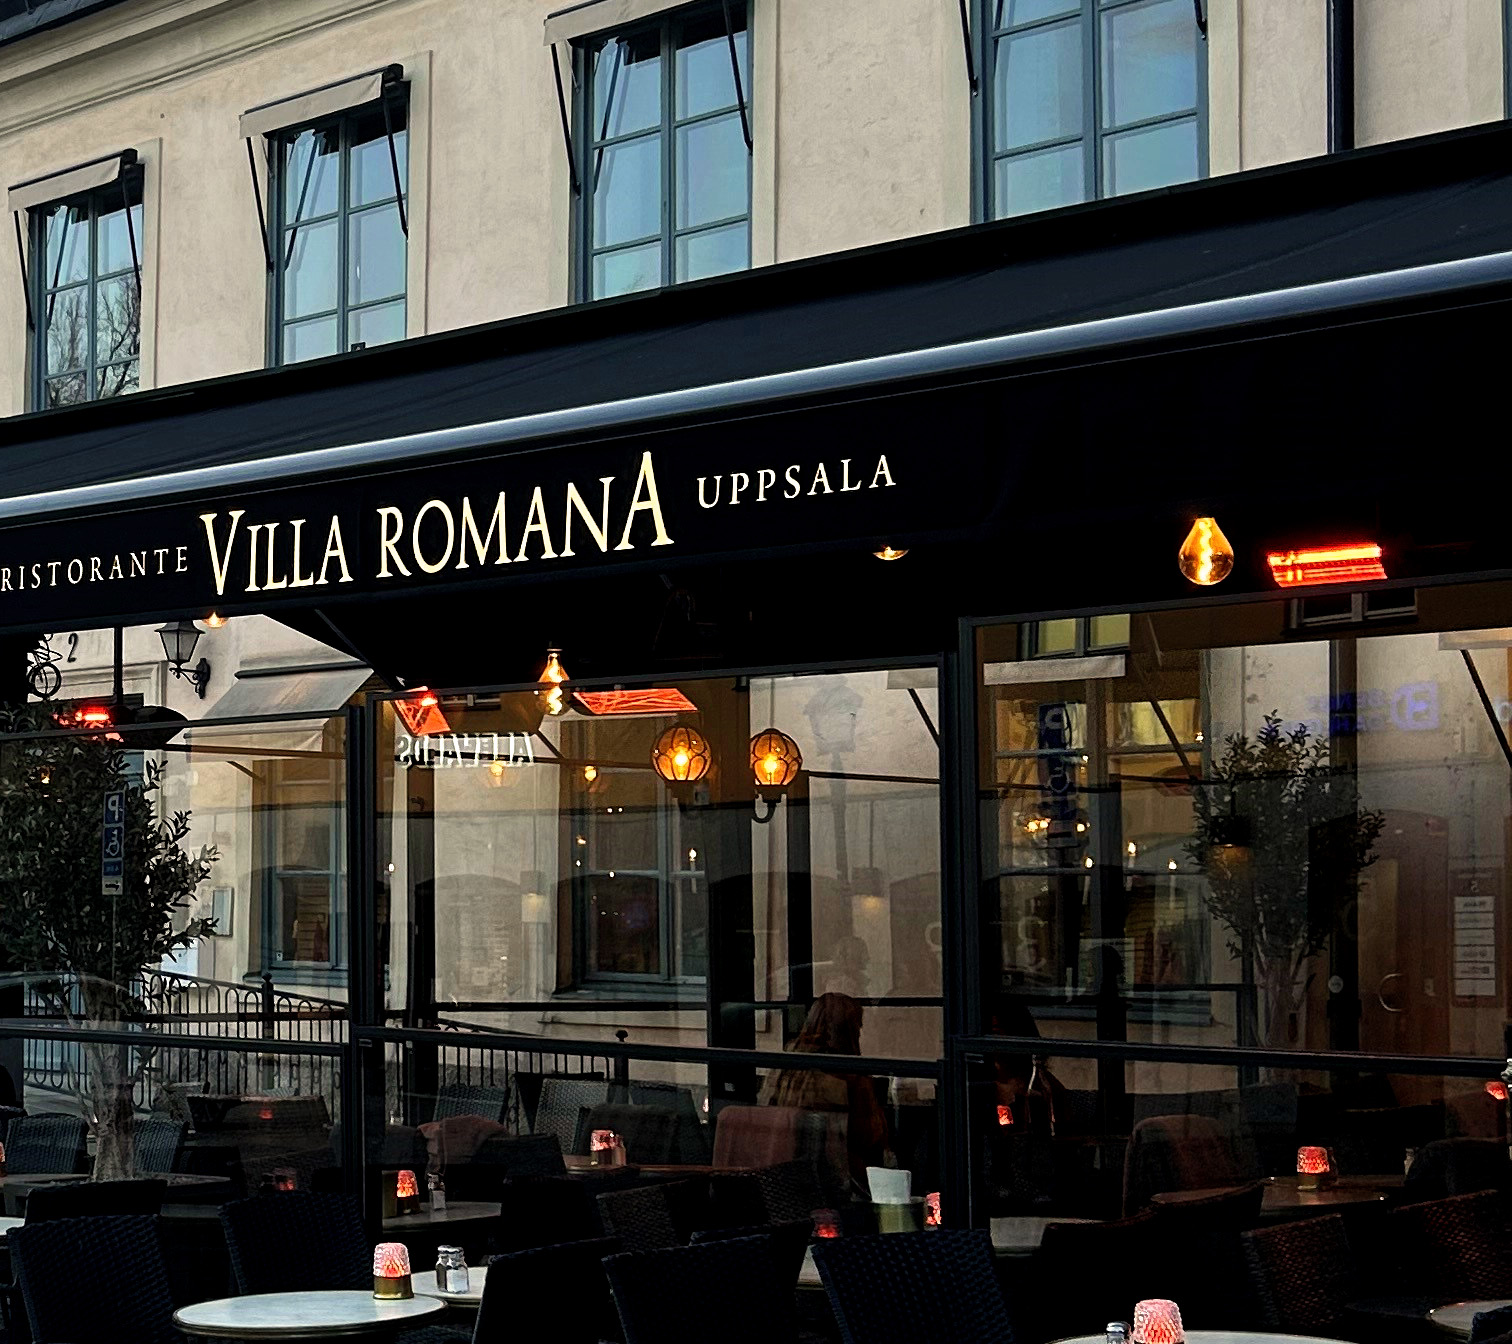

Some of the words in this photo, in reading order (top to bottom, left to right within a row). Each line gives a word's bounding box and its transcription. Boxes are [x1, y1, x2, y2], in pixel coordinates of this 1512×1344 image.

[0, 545, 189, 593] RISTORANTE
[198, 509, 354, 596] VILLA
[375, 450, 676, 579] ROMANA
[696, 453, 898, 510] UPPSALA
[67, 633, 79, 663] 2
